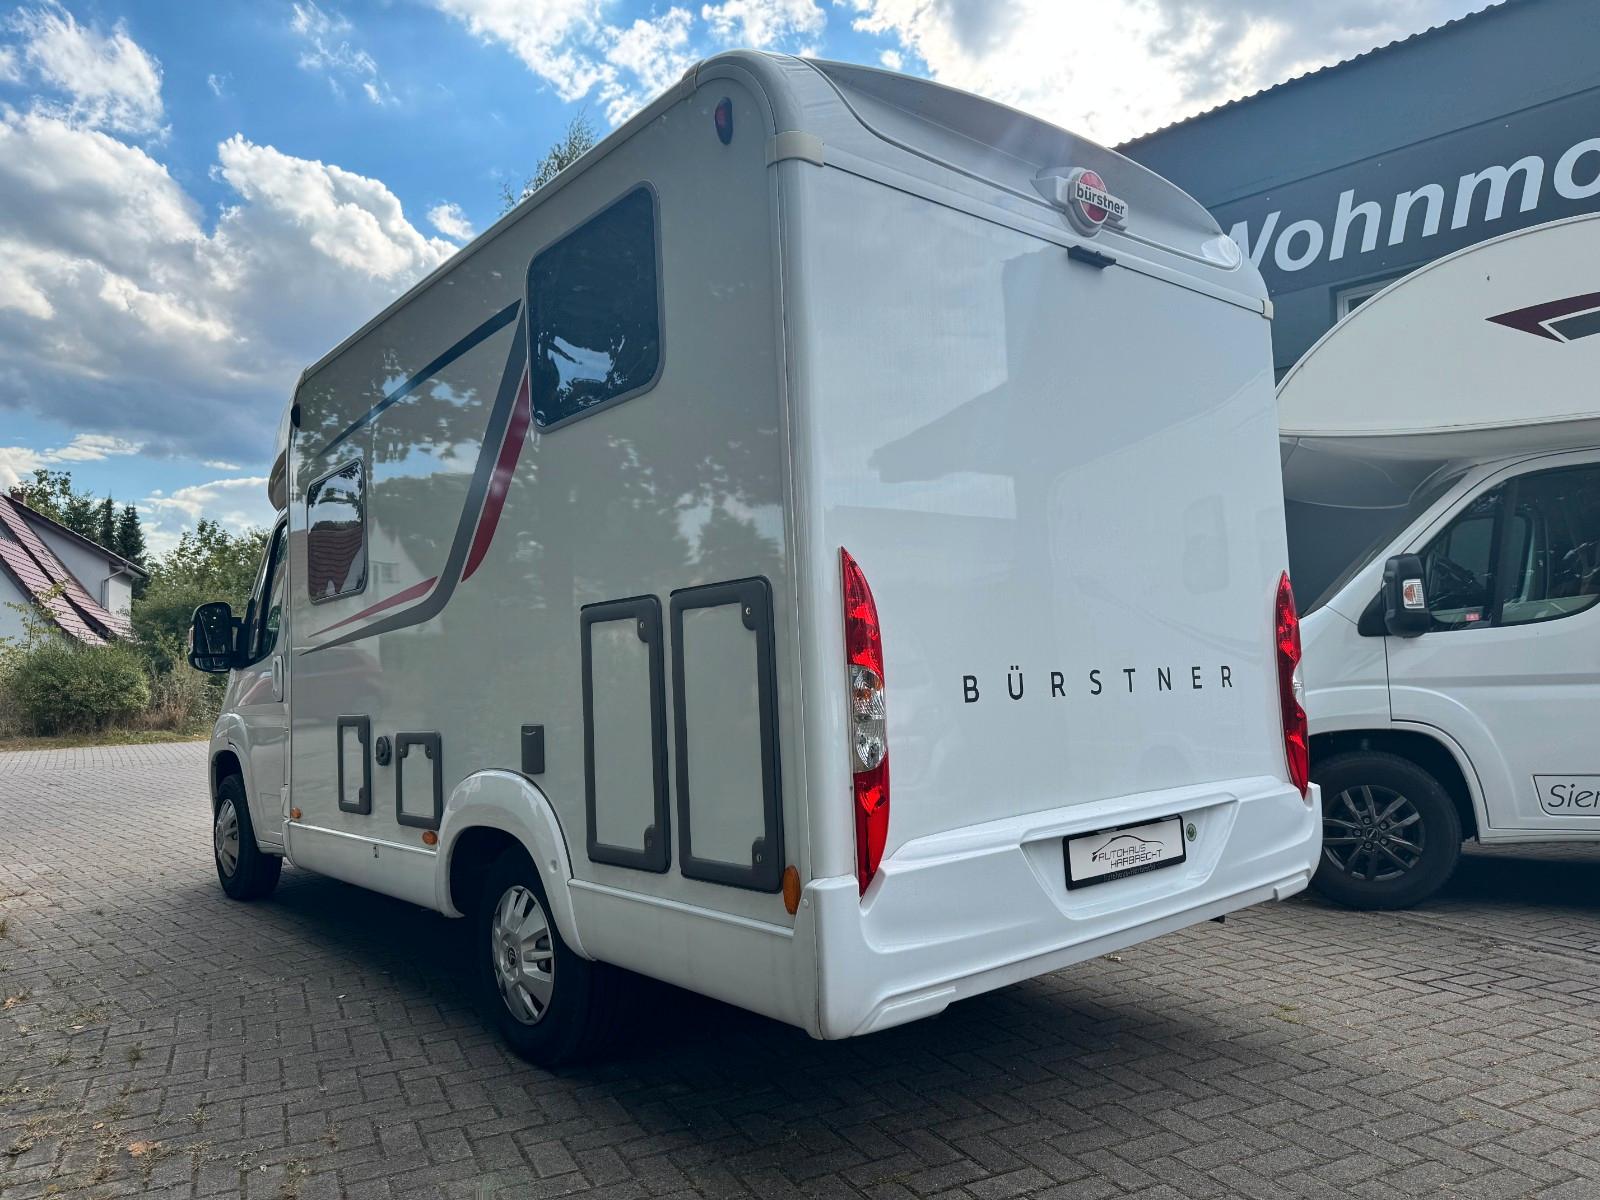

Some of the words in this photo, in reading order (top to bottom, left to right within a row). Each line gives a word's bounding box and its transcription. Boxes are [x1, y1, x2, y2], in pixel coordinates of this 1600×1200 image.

[1076, 182, 1125, 215] bürstner
[962, 665, 1233, 703] BÜRSTNER
[1098, 843, 1147, 863] AUTOHAUS
